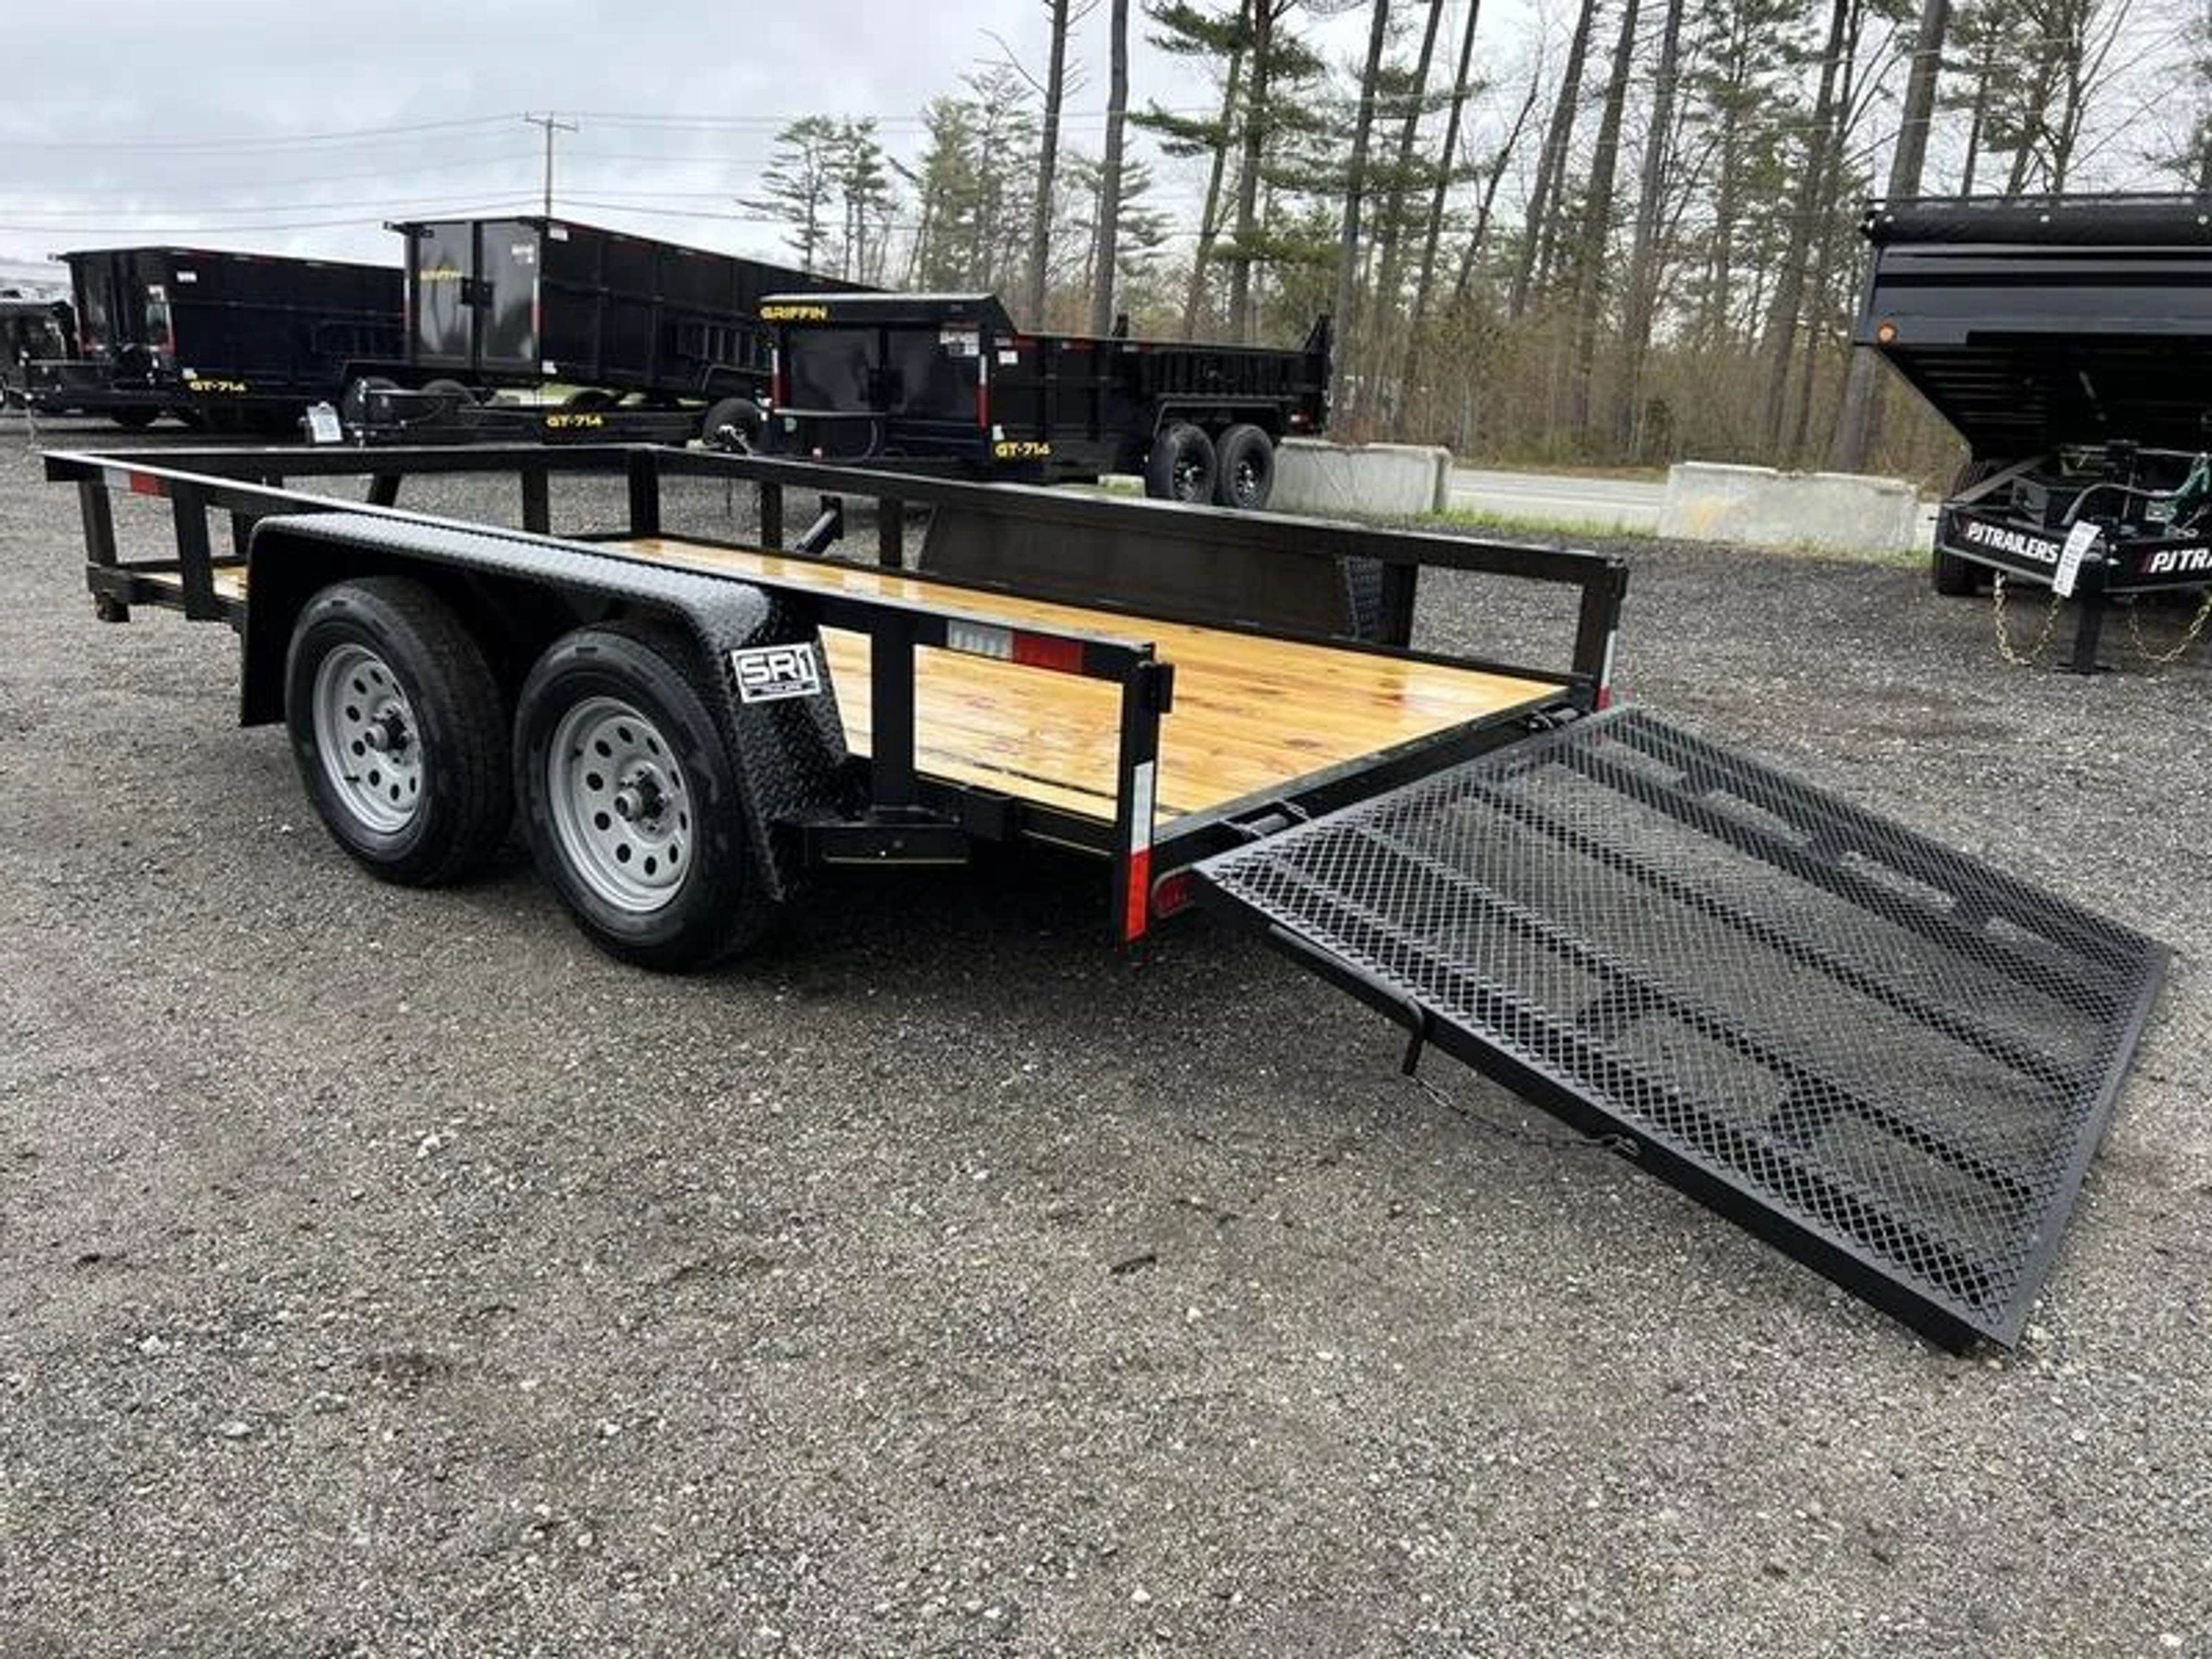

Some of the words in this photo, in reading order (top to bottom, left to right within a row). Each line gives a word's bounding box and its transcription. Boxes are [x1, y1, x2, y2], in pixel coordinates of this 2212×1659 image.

[760, 306, 827, 319] GRIFFIN
[546, 414, 603, 427] GT-714
[995, 441, 1051, 457] GT-714
[740, 649, 815, 683] SR1
